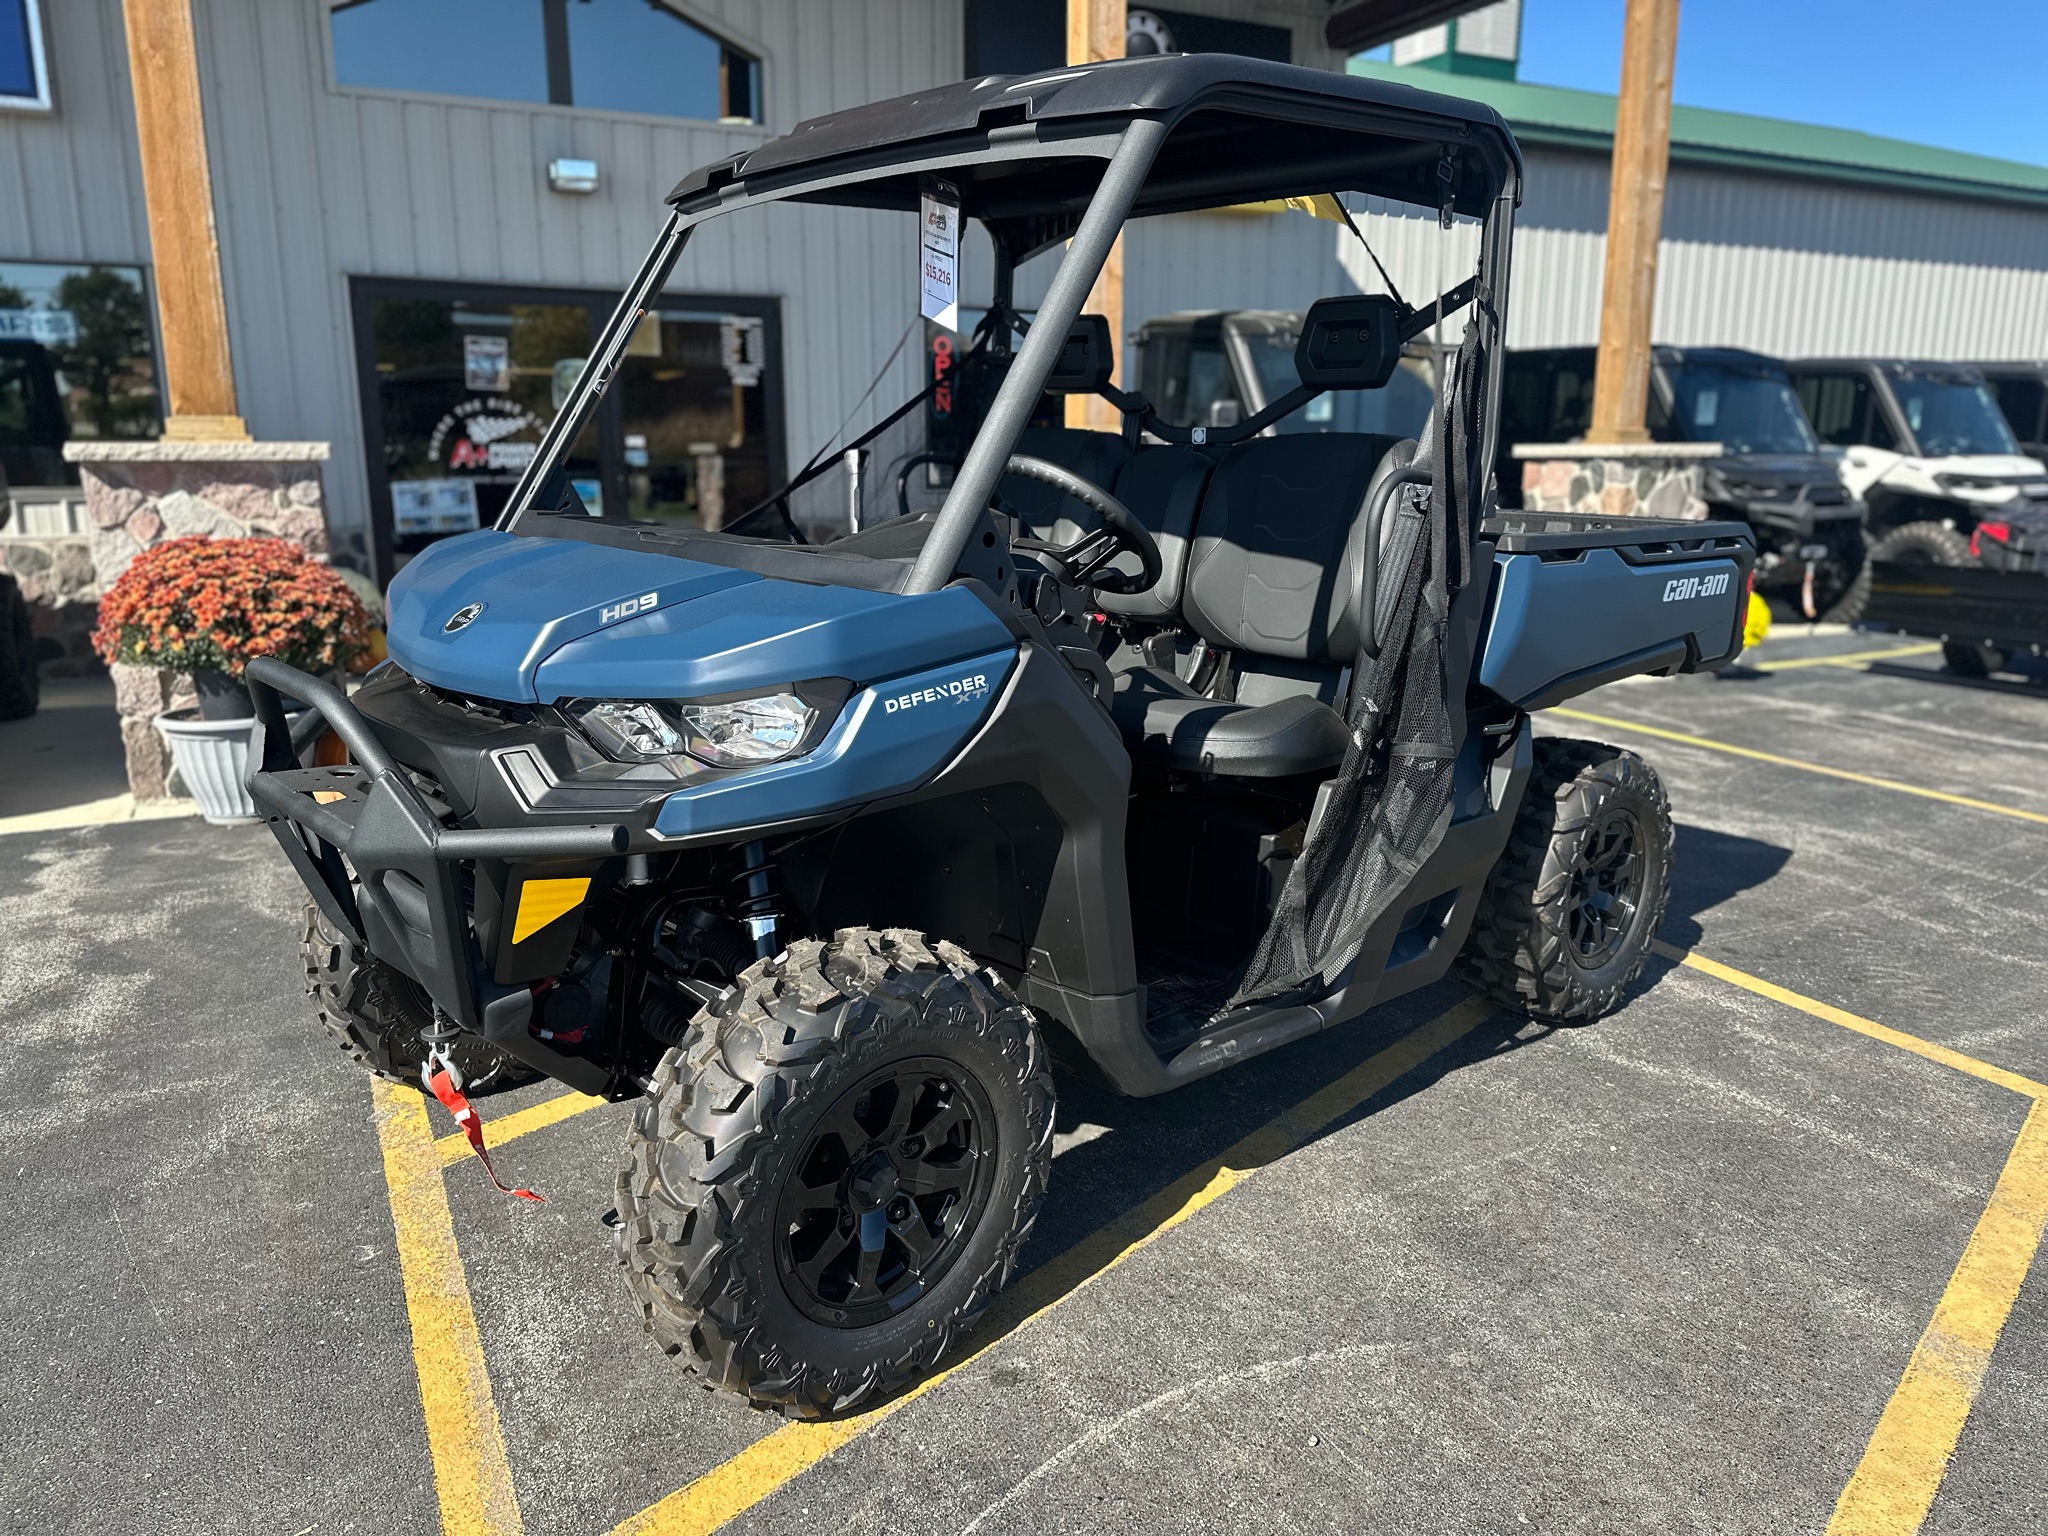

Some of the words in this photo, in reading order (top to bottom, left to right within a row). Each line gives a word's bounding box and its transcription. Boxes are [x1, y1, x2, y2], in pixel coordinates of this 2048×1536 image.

[925, 261, 951, 287] $15,216
[453, 398, 483, 418] THE
[486, 397, 523, 416] RIDE
[489, 455, 535, 470] SPORT
[454, 615, 470, 624] BRP
[601, 592, 658, 624] HD9
[884, 675, 986, 713] DEFENDER
